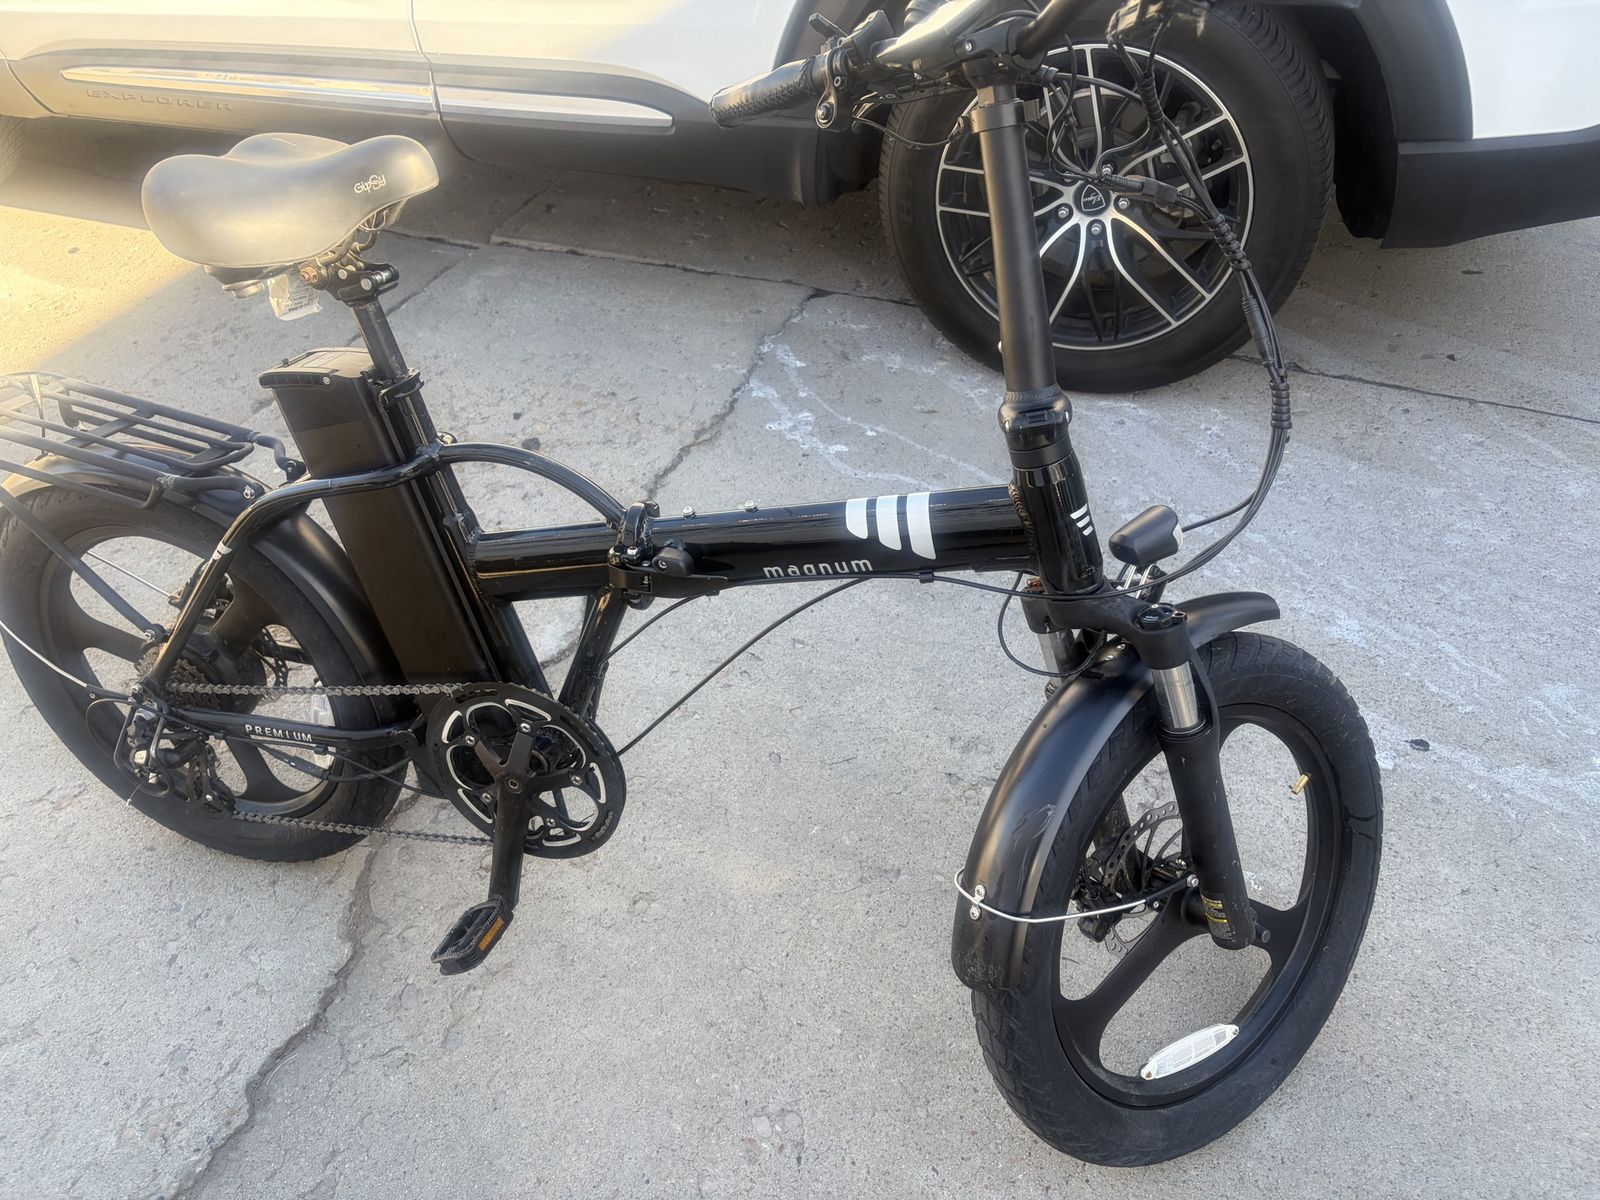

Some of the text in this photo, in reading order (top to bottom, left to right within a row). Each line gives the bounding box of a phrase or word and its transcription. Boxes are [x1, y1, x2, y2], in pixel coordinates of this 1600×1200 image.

[87, 89, 233, 112] EXPLORER
[762, 559, 874, 578] magnum
[244, 723, 313, 742] PREMIUM
